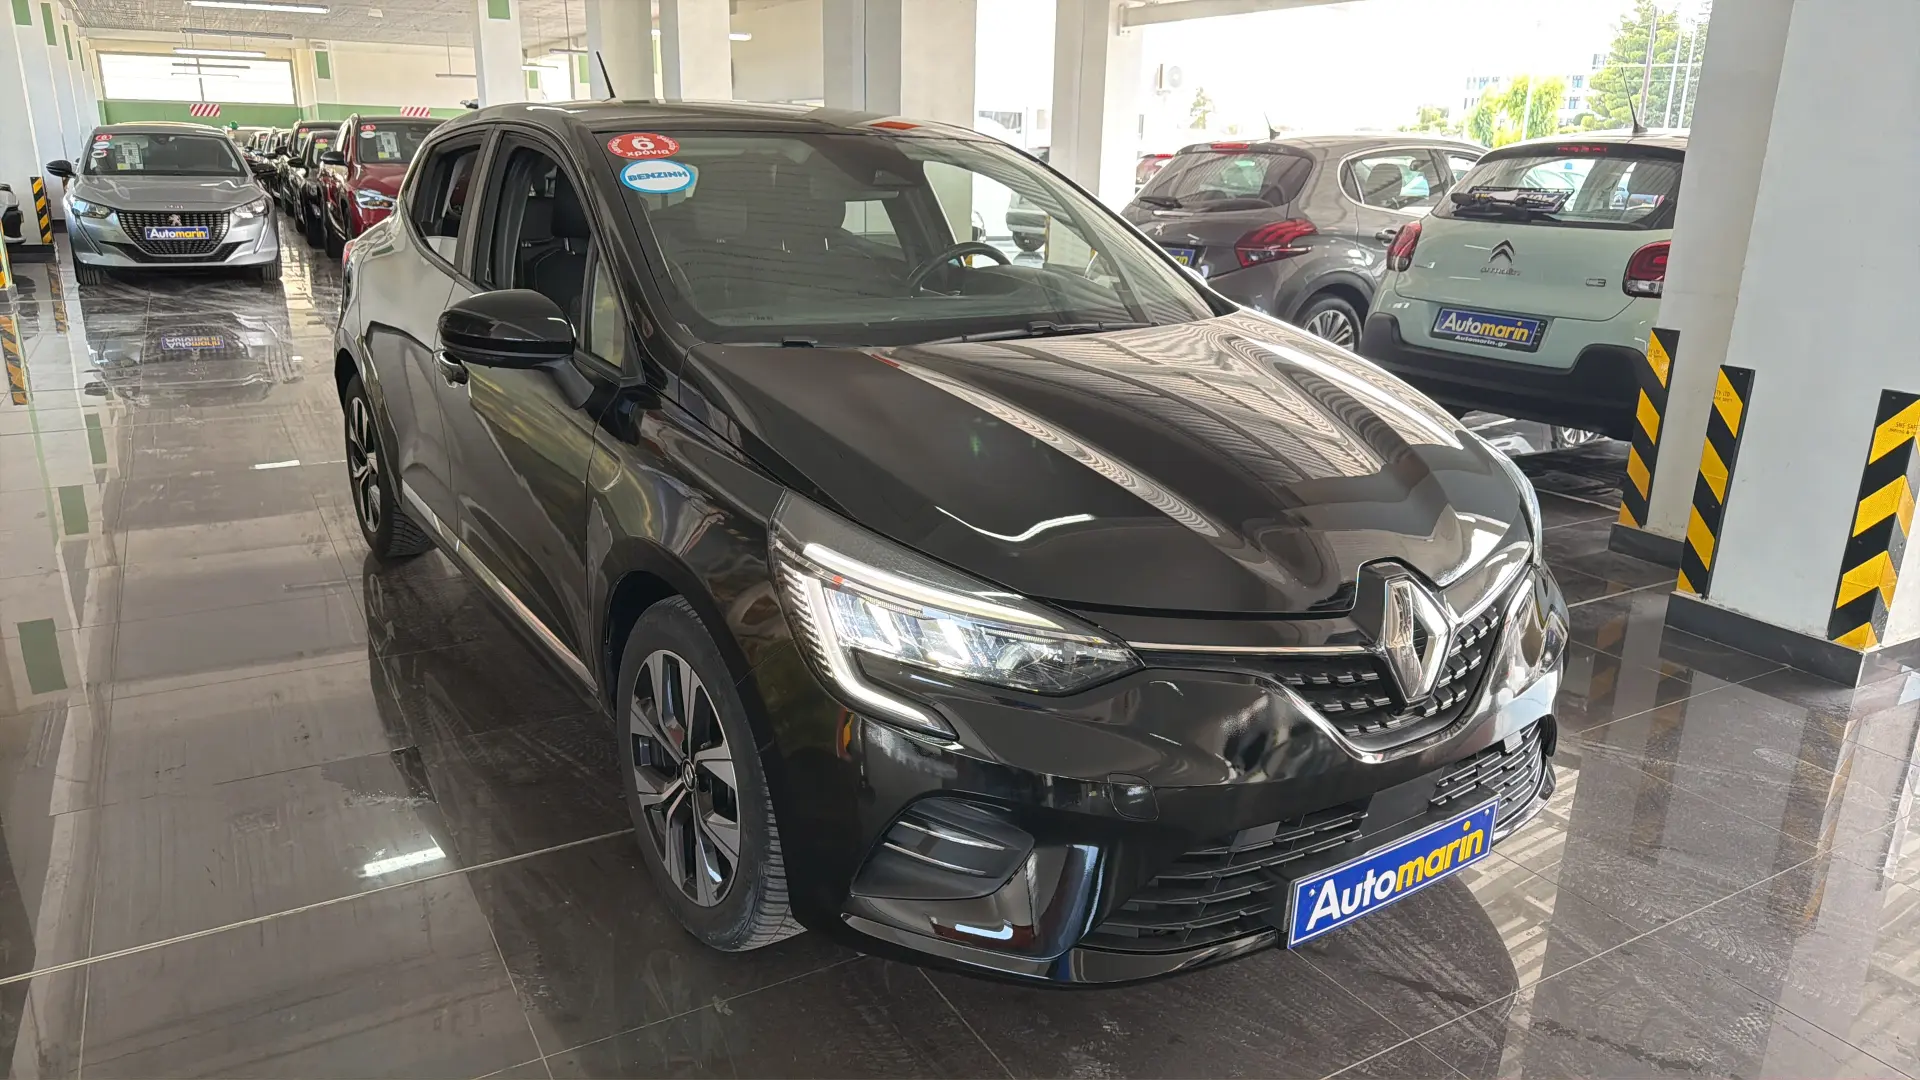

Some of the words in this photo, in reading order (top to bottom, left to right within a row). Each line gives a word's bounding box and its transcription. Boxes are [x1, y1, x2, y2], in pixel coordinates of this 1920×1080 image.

[631, 137, 655, 150] 6
[626, 149, 670, 157] χρόνια
[150, 227, 206, 239] Automarin
[1585, 278, 1607, 287] C3
[1441, 312, 1529, 342] Automarin
[1455, 335, 1508, 347] Automarin.gr
[1305, 820, 1484, 932] Automarin
